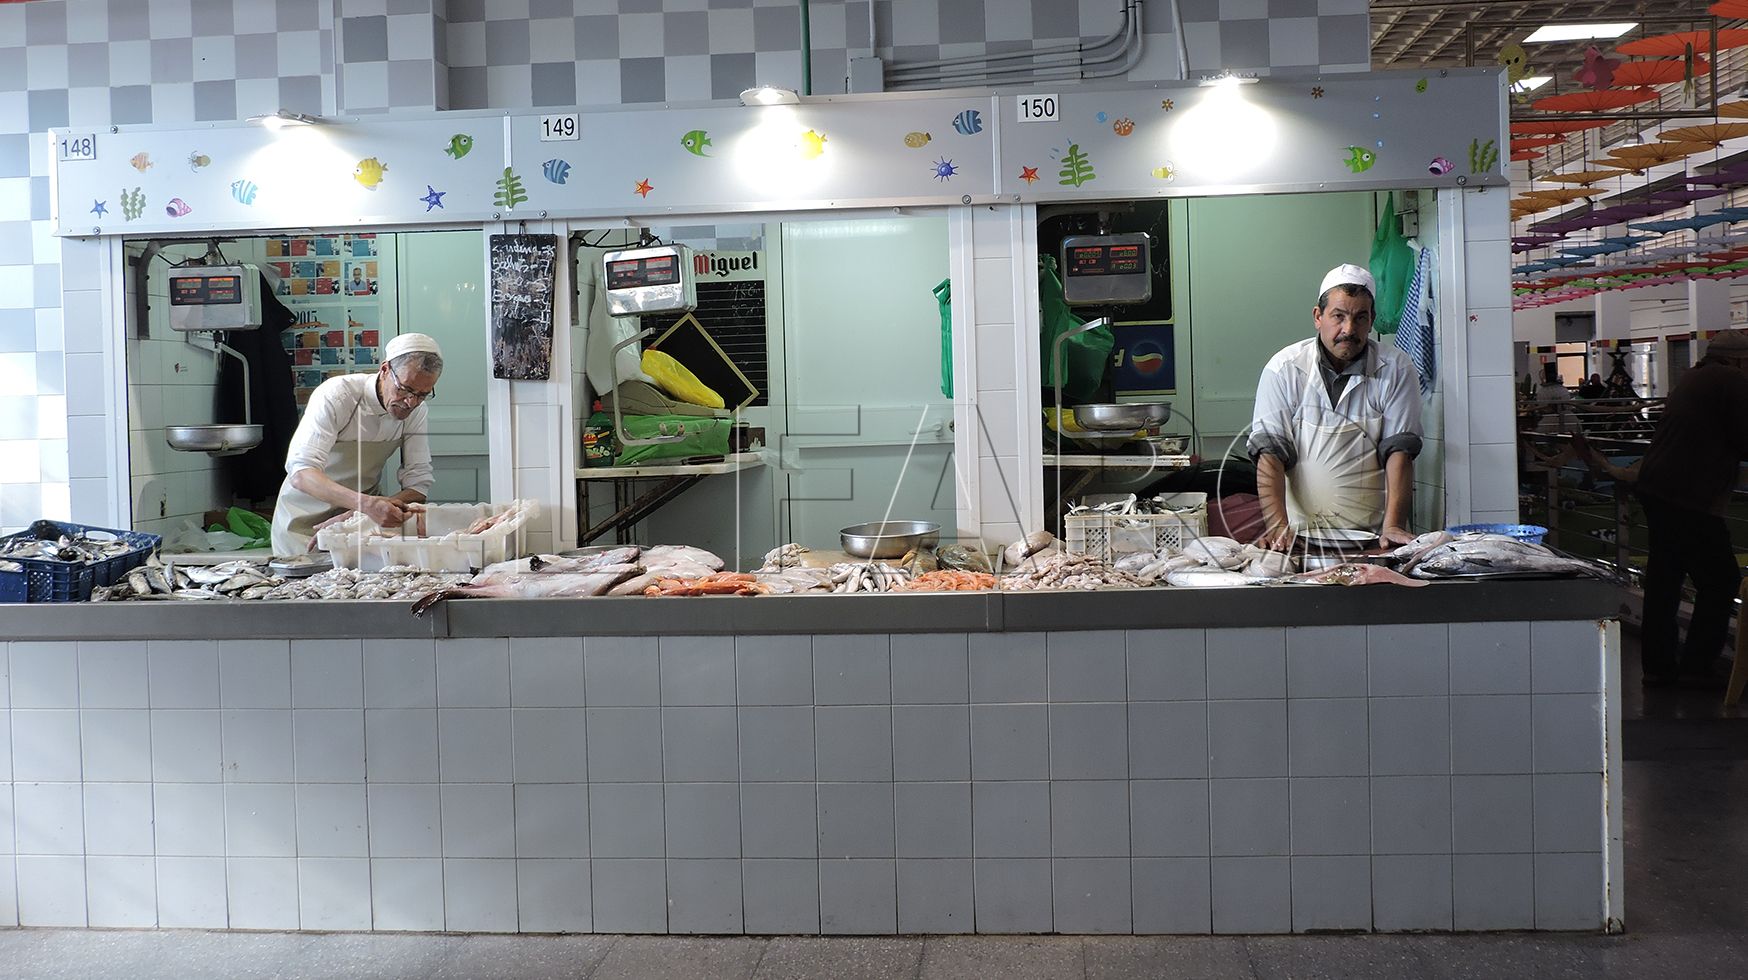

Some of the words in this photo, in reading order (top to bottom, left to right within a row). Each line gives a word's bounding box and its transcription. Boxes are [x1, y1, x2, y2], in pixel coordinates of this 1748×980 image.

[1021, 97, 1055, 118] 150
[543, 117, 575, 137] 149
[61, 138, 91, 157] 148
[693, 251, 758, 277] Miguel
